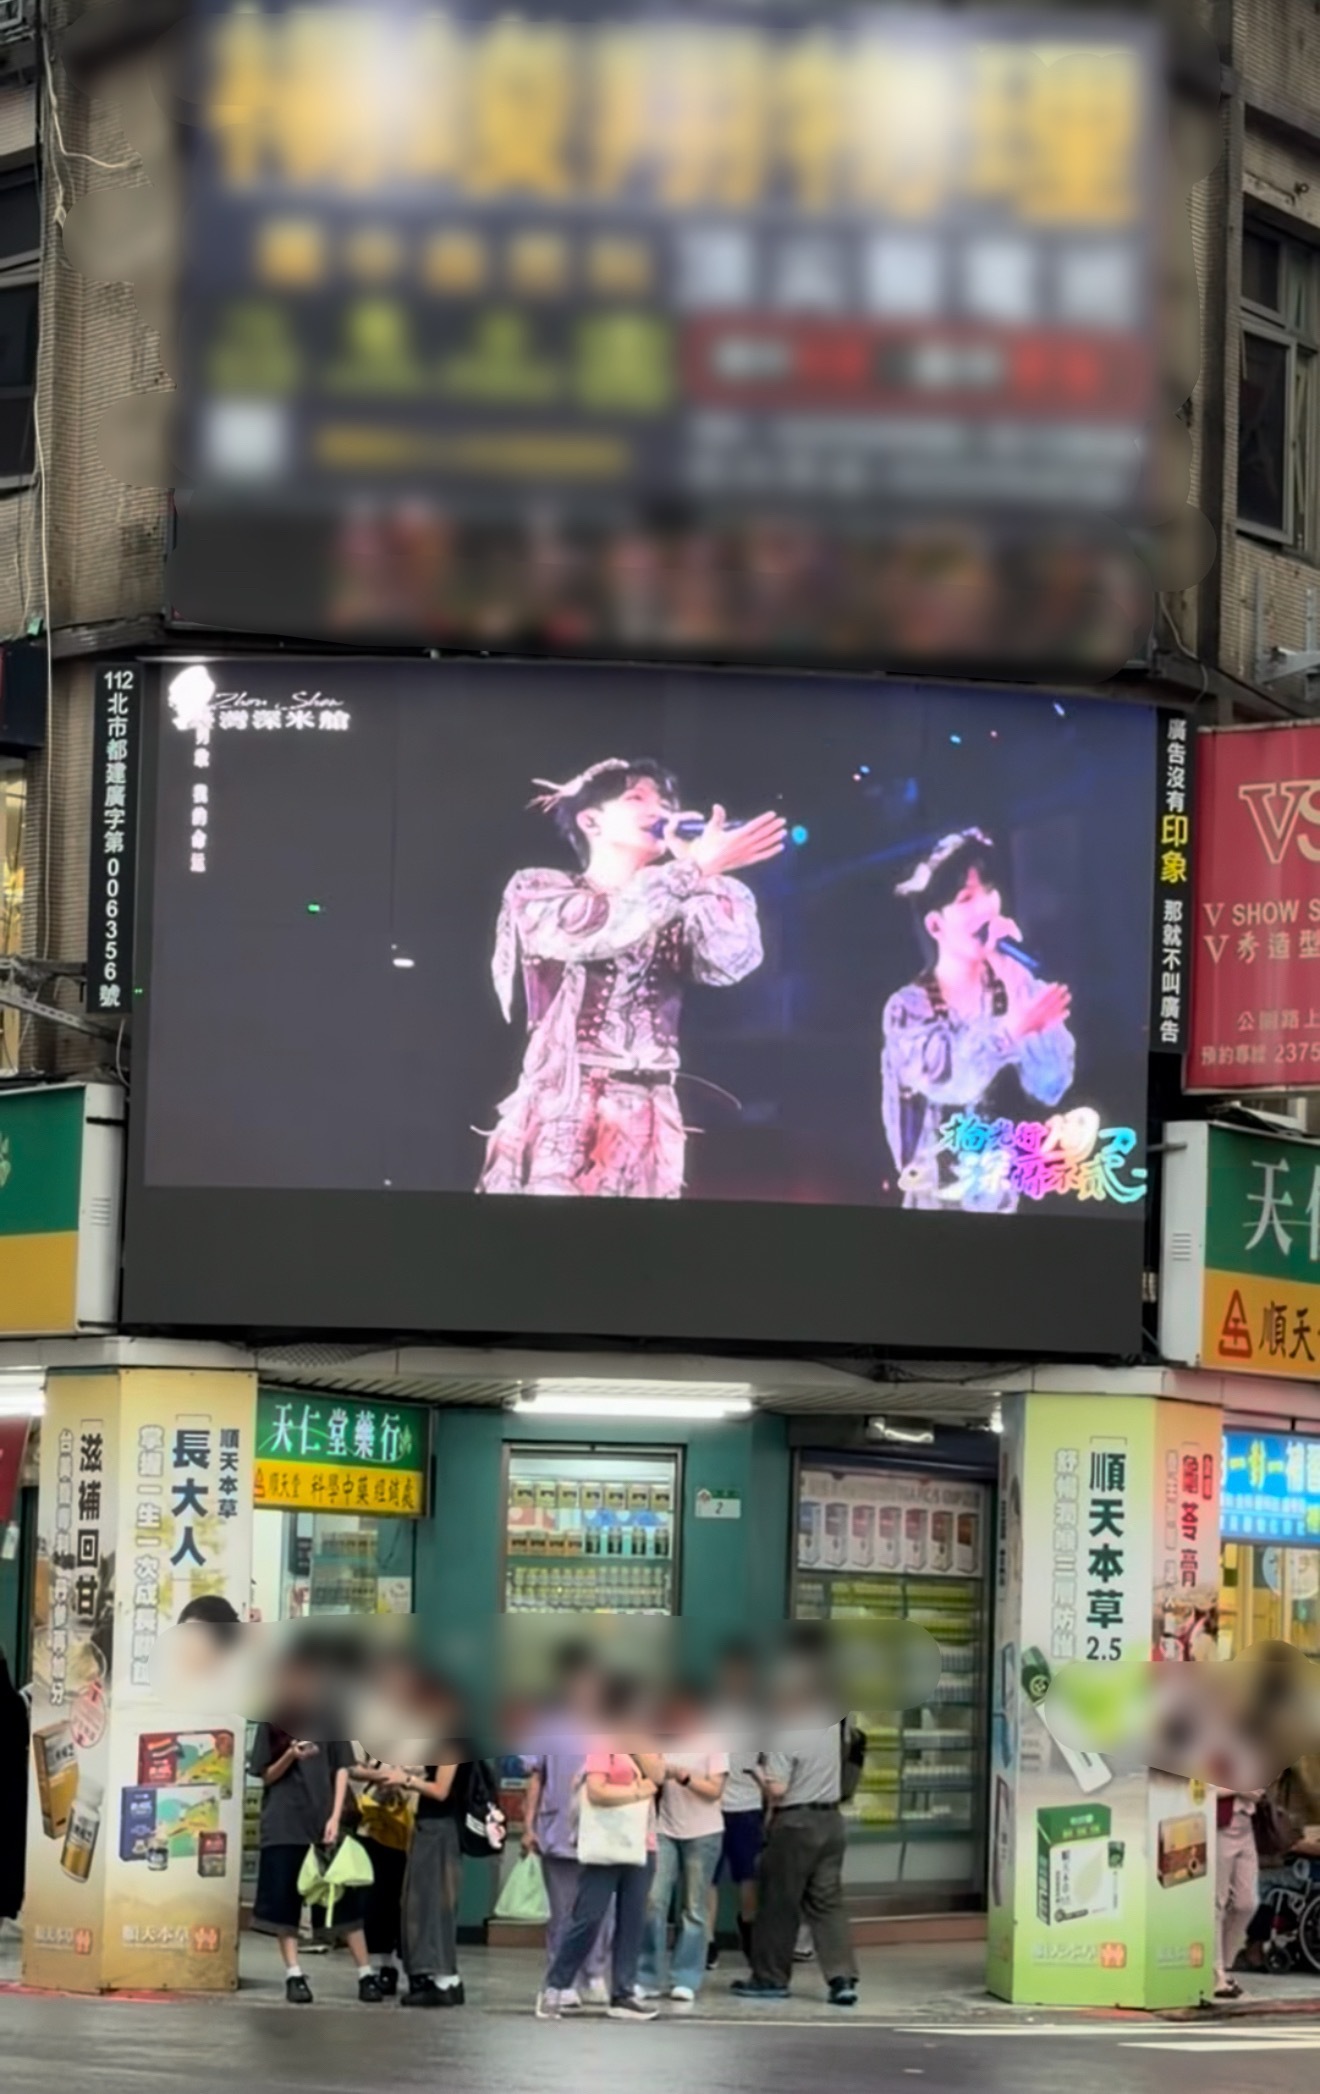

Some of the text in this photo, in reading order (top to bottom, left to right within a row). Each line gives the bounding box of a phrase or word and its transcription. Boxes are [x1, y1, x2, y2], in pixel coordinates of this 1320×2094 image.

[1203, 903, 1225, 928] V
[1231, 900, 1300, 926] SHOW
[217, 1428, 240, 1519] 順天本草
[270, 1402, 402, 1463] 天仁堂藥行
[170, 1429, 212, 1567] 長大人
[1086, 1451, 1127, 1629] 順天本草
